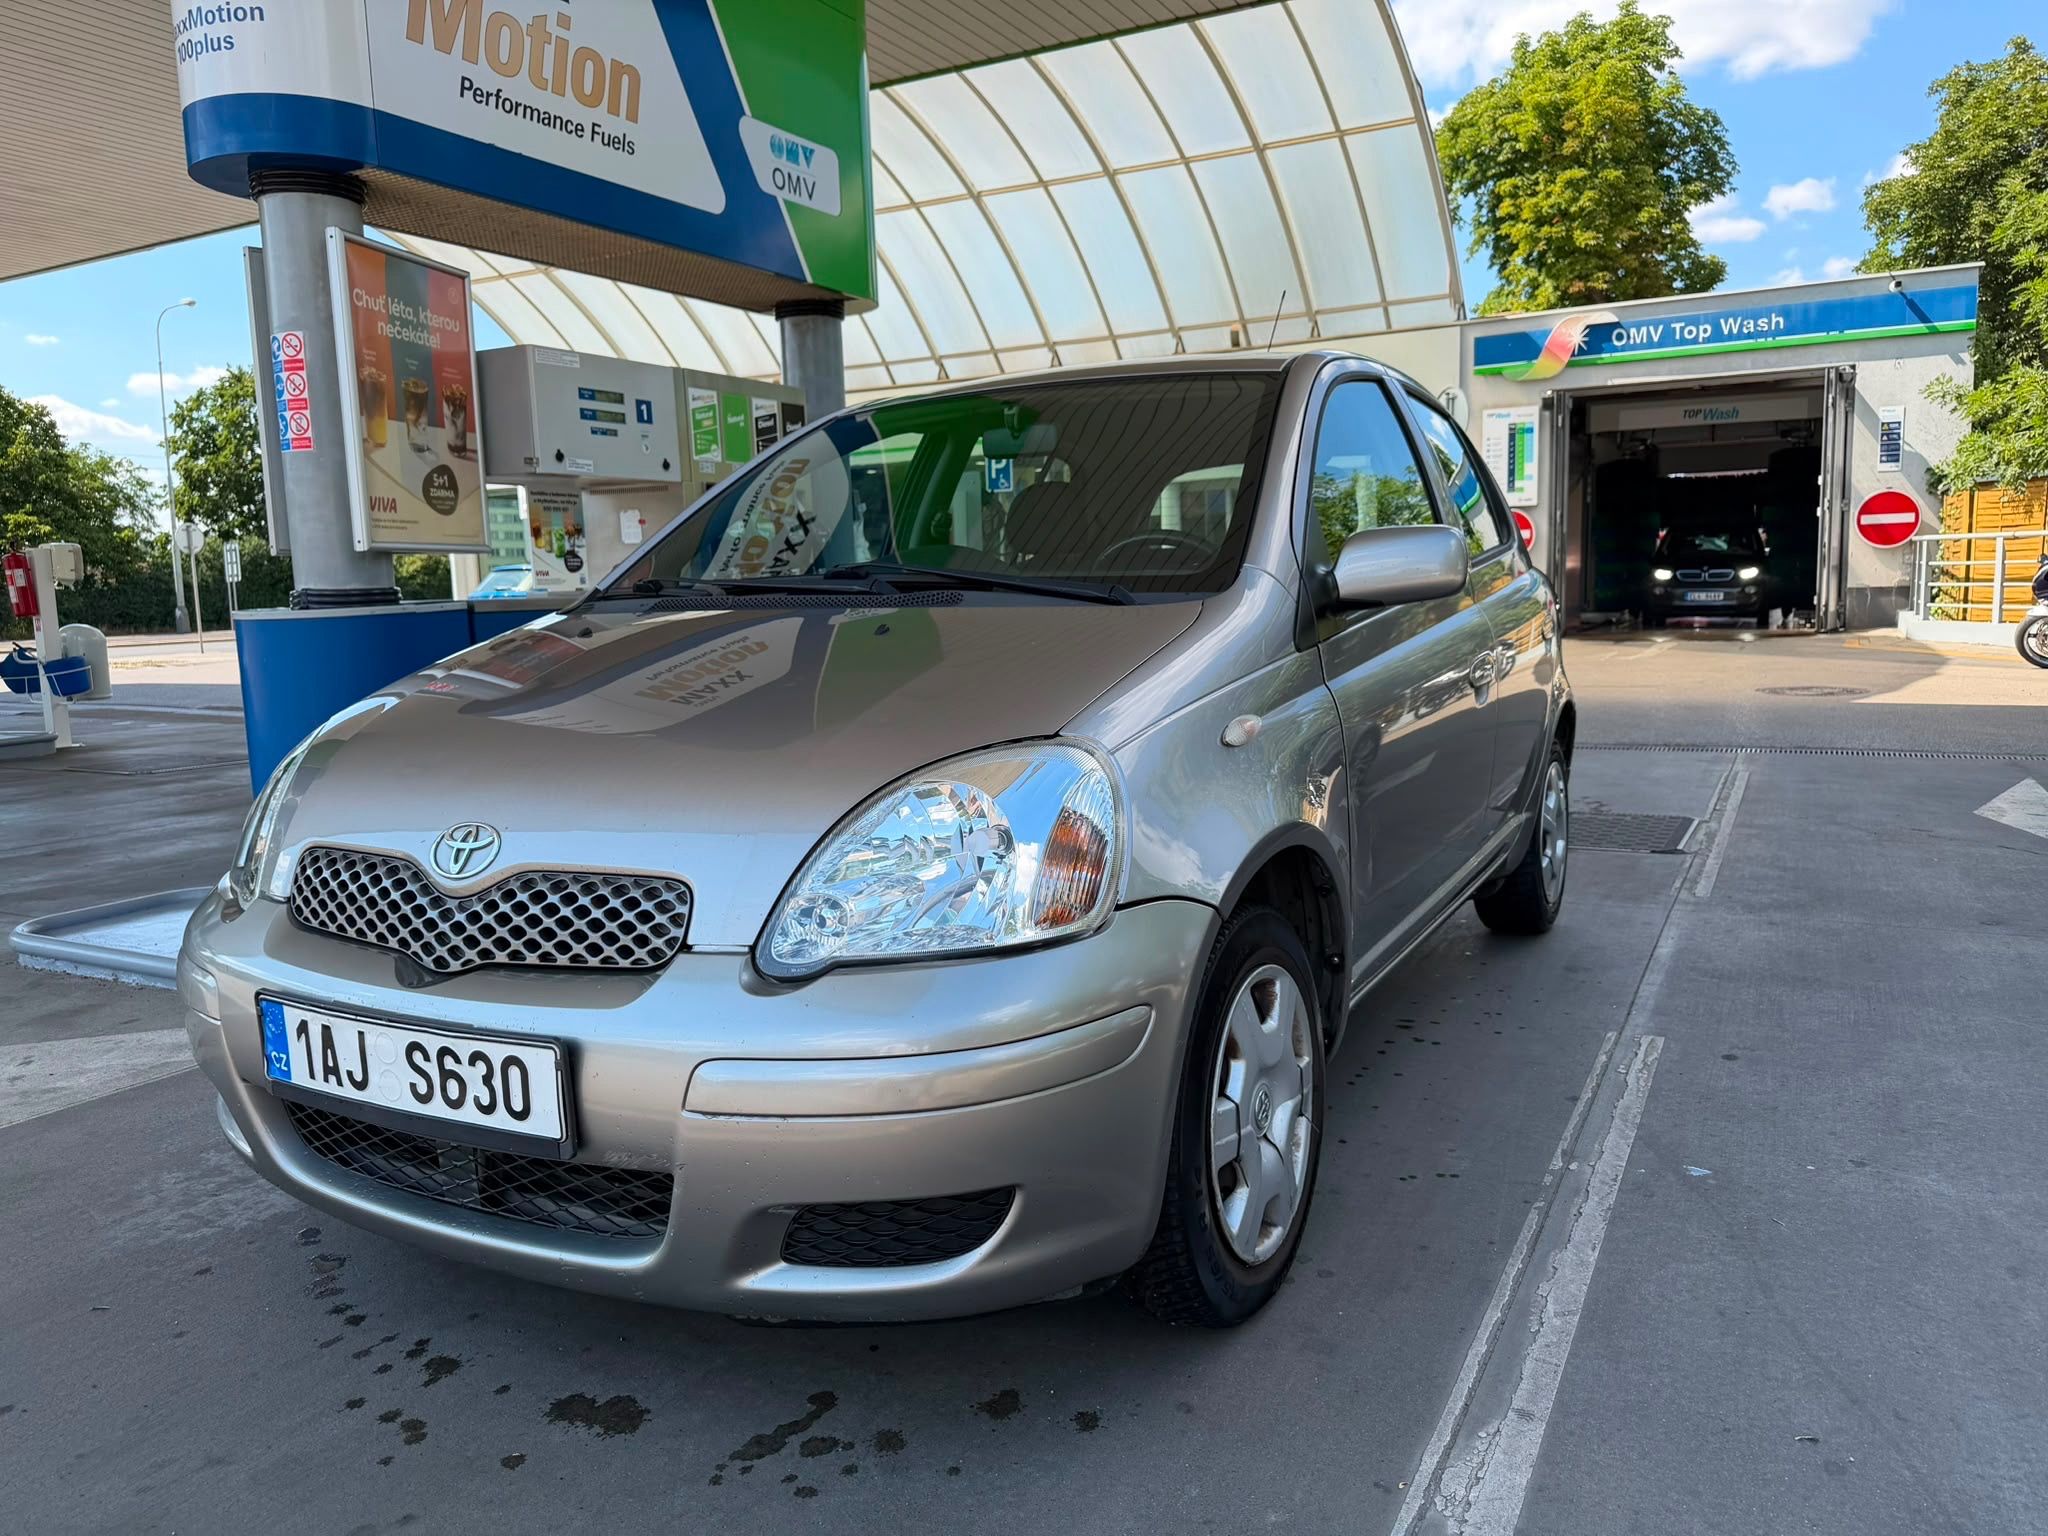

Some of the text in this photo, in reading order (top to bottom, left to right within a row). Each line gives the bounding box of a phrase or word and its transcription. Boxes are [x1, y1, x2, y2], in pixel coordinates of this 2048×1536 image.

[178, 33, 235, 65] 100plus
[406, 0, 641, 124] Motion
[459, 75, 636, 156] Performance Fuels
[769, 134, 815, 170] OMV
[772, 167, 816, 201] OMV
[353, 288, 460, 332] Chuť léta, kterou
[377, 320, 441, 349] nečekáte!
[1612, 313, 1784, 346] OMV Top Wash
[640, 403, 648, 421] 1
[432, 473, 449, 487] 5+1
[991, 458, 1007, 479] P
[369, 495, 398, 514] VIVA
[430, 487, 456, 498] ZDARMA
[270, 1051, 289, 1072] CZ
[296, 1019, 531, 1122] 1AJ S630
